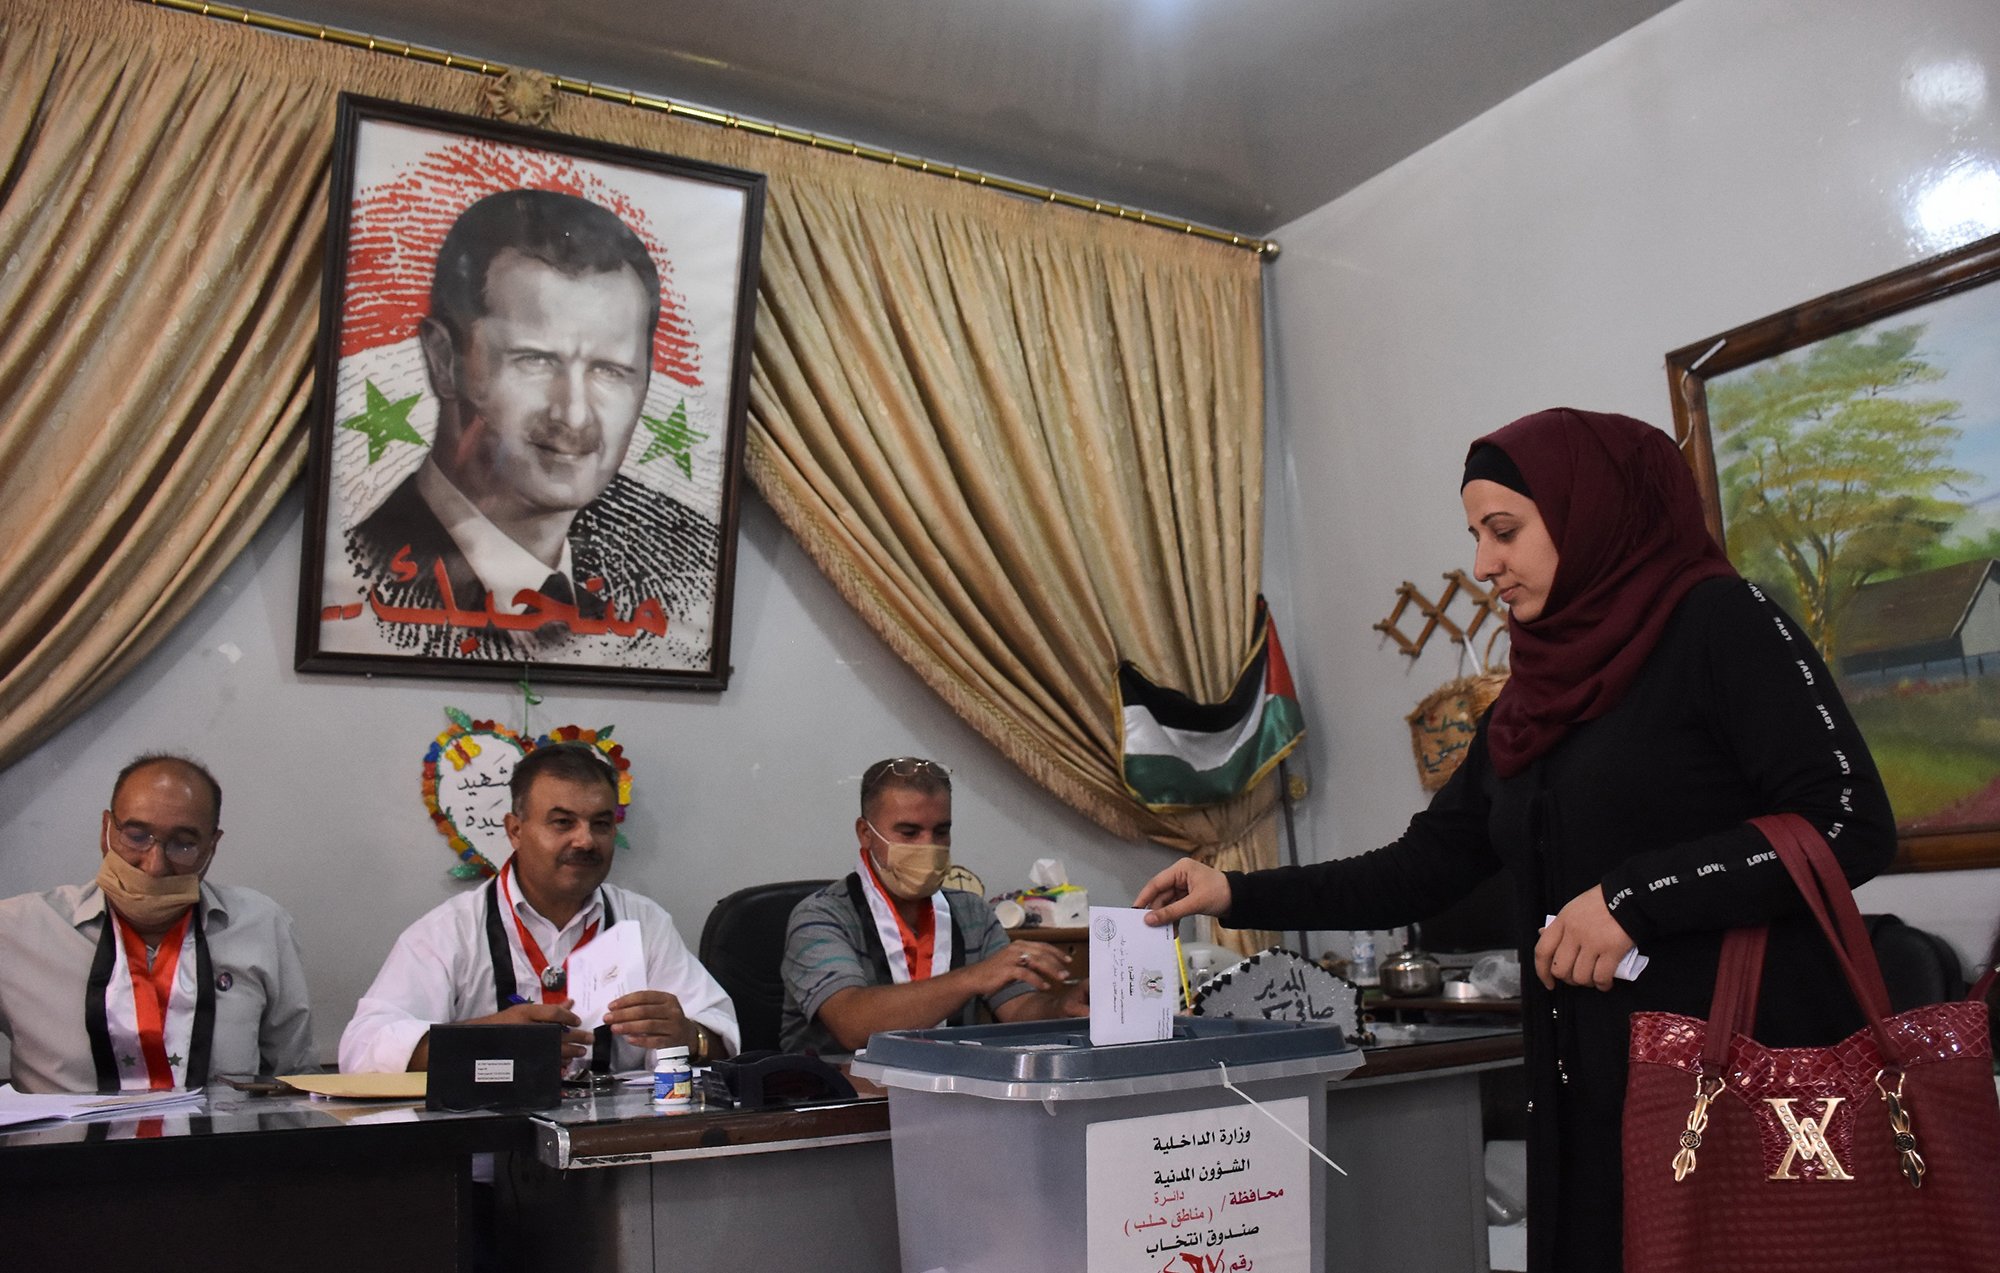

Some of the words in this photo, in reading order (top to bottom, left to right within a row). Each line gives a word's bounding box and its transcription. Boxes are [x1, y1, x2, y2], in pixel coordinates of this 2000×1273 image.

[1748, 583, 1767, 603] LOV
[1773, 616, 1793, 641] LOVE
[1795, 659, 1815, 686] LOVE
[1816, 704, 1836, 730] LOVE
[1746, 850, 1778, 867] LOVE
[1697, 862, 1727, 877] LOVE
[1648, 875, 1680, 892] LOVE
[1608, 887, 1634, 911] LOVE
[1153, 1132, 1215, 1155] الداخلية
[1219, 1127, 1251, 1144] وزارة
[1154, 1168, 1195, 1188] المدنية
[1200, 1159, 1250, 1182] الشؤون
[1229, 1187, 1284, 1206] محافظة
[1146, 1232, 1202, 1258] انتخاب
[1206, 1223, 1260, 1247] صندوق
[1229, 1254, 1253, 1273] رقم
